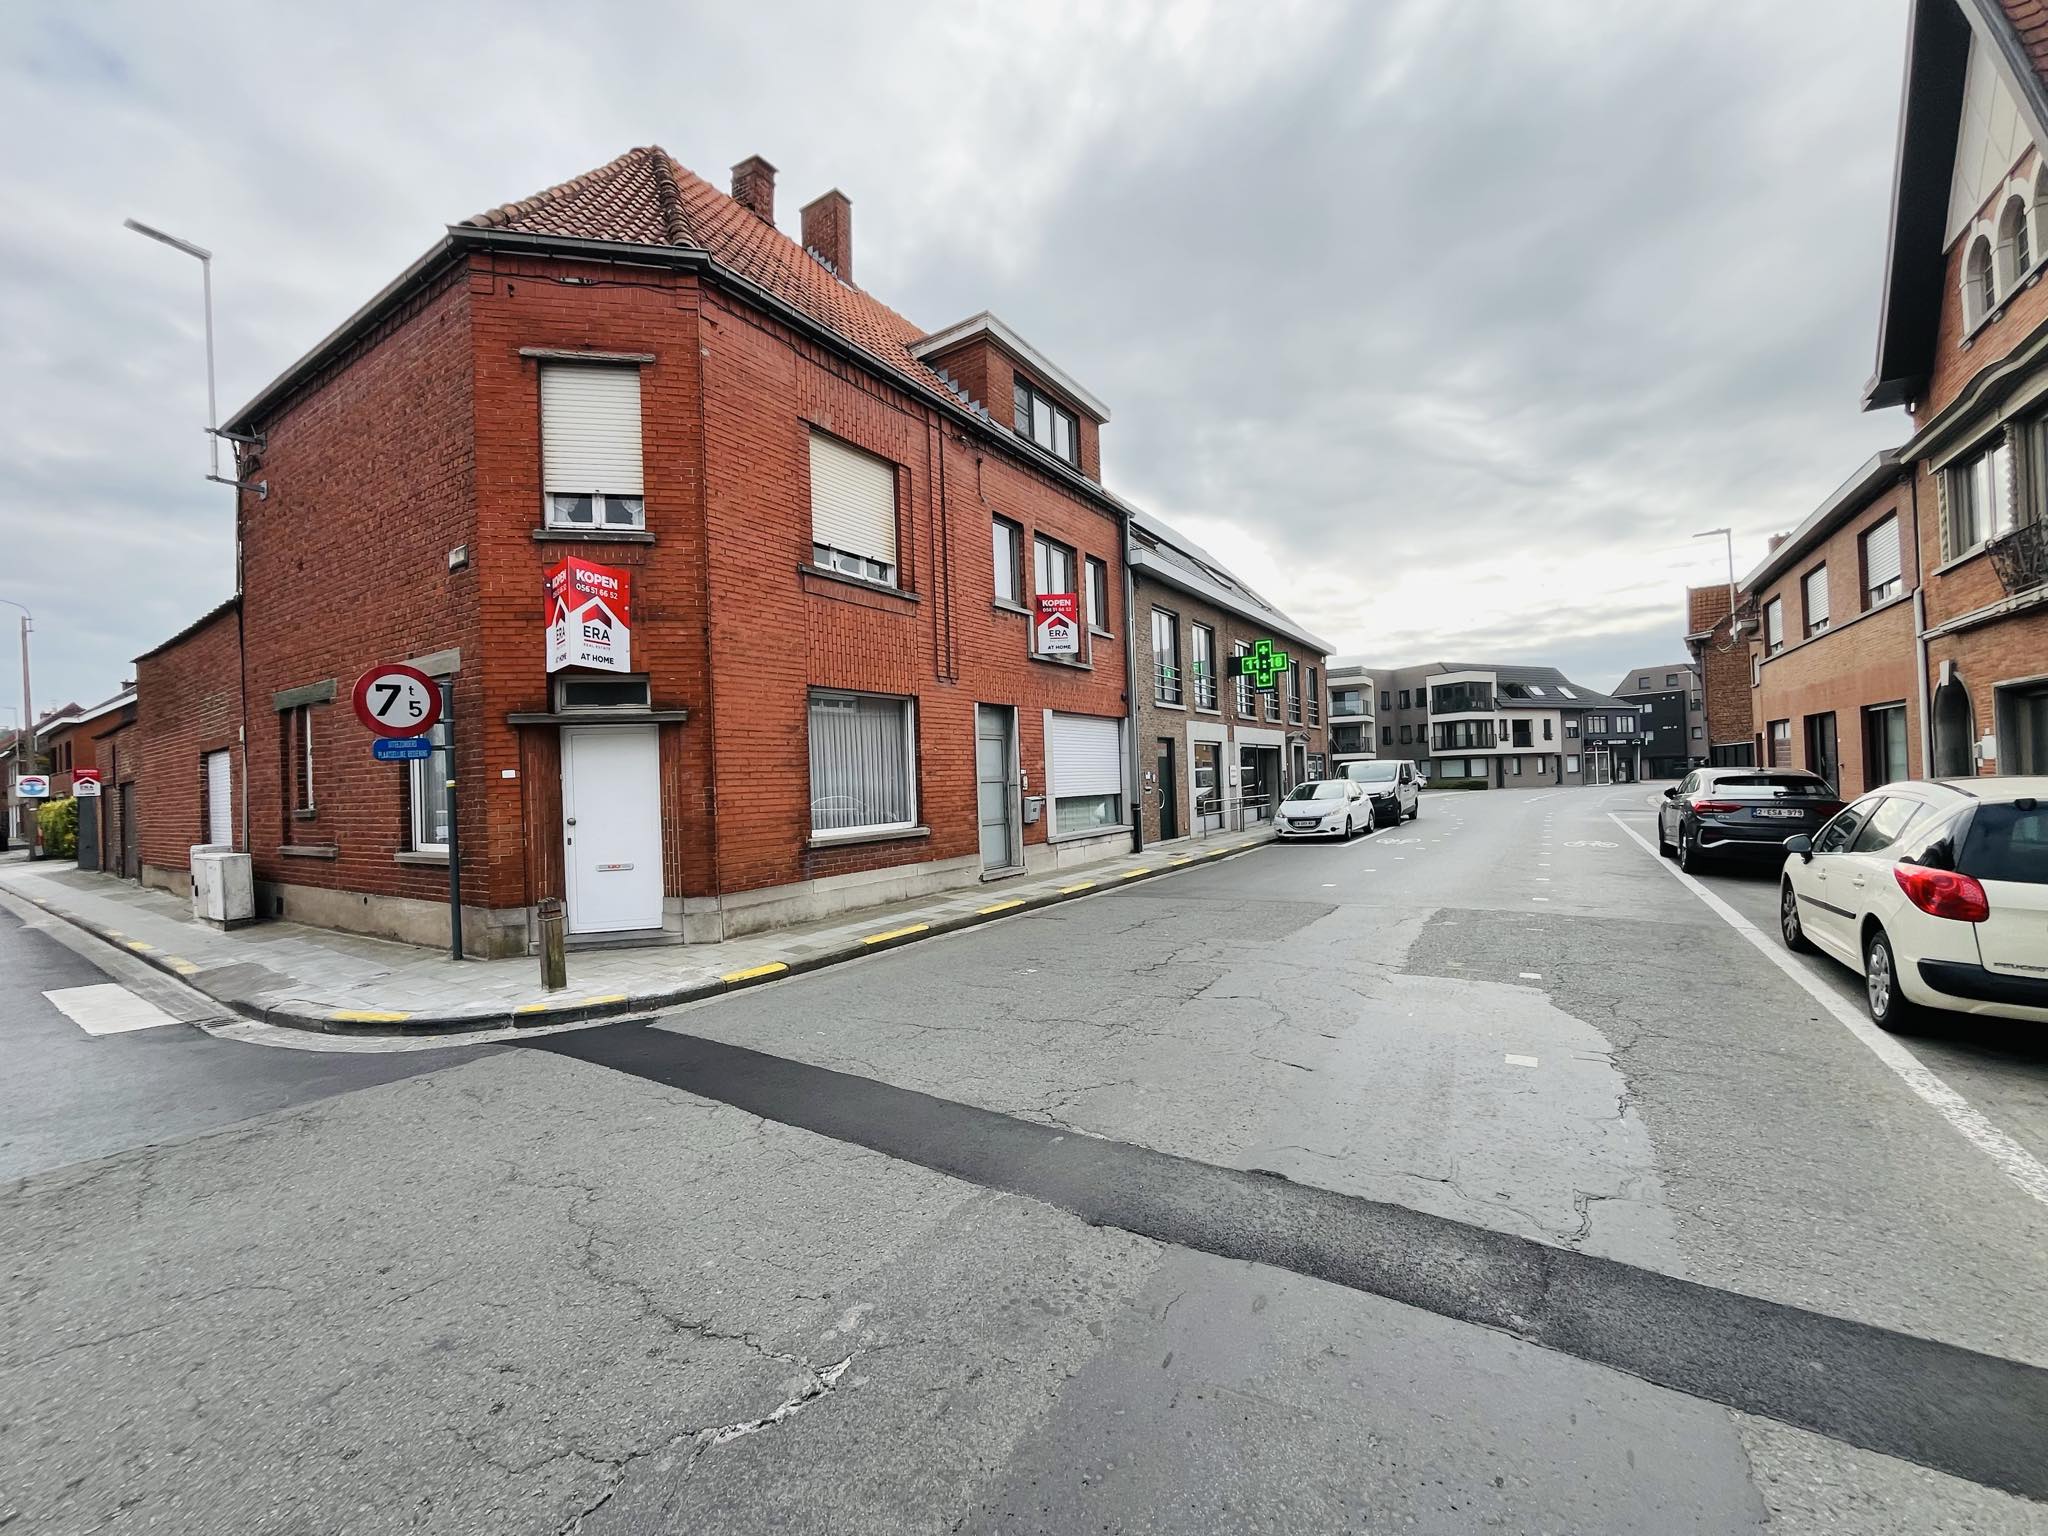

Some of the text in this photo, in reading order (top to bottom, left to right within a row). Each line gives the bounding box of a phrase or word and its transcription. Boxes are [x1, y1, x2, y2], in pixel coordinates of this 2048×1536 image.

[575, 568, 618, 590] KOPEN
[575, 583, 590, 593] 056
[590, 586, 598, 595] 51
[610, 591, 618, 599] 52
[1042, 599, 1071, 607] KOPEN
[583, 625, 611, 642] ERA
[580, 653, 615, 665] AT HOME
[375, 683, 422, 717] 7 t 5
